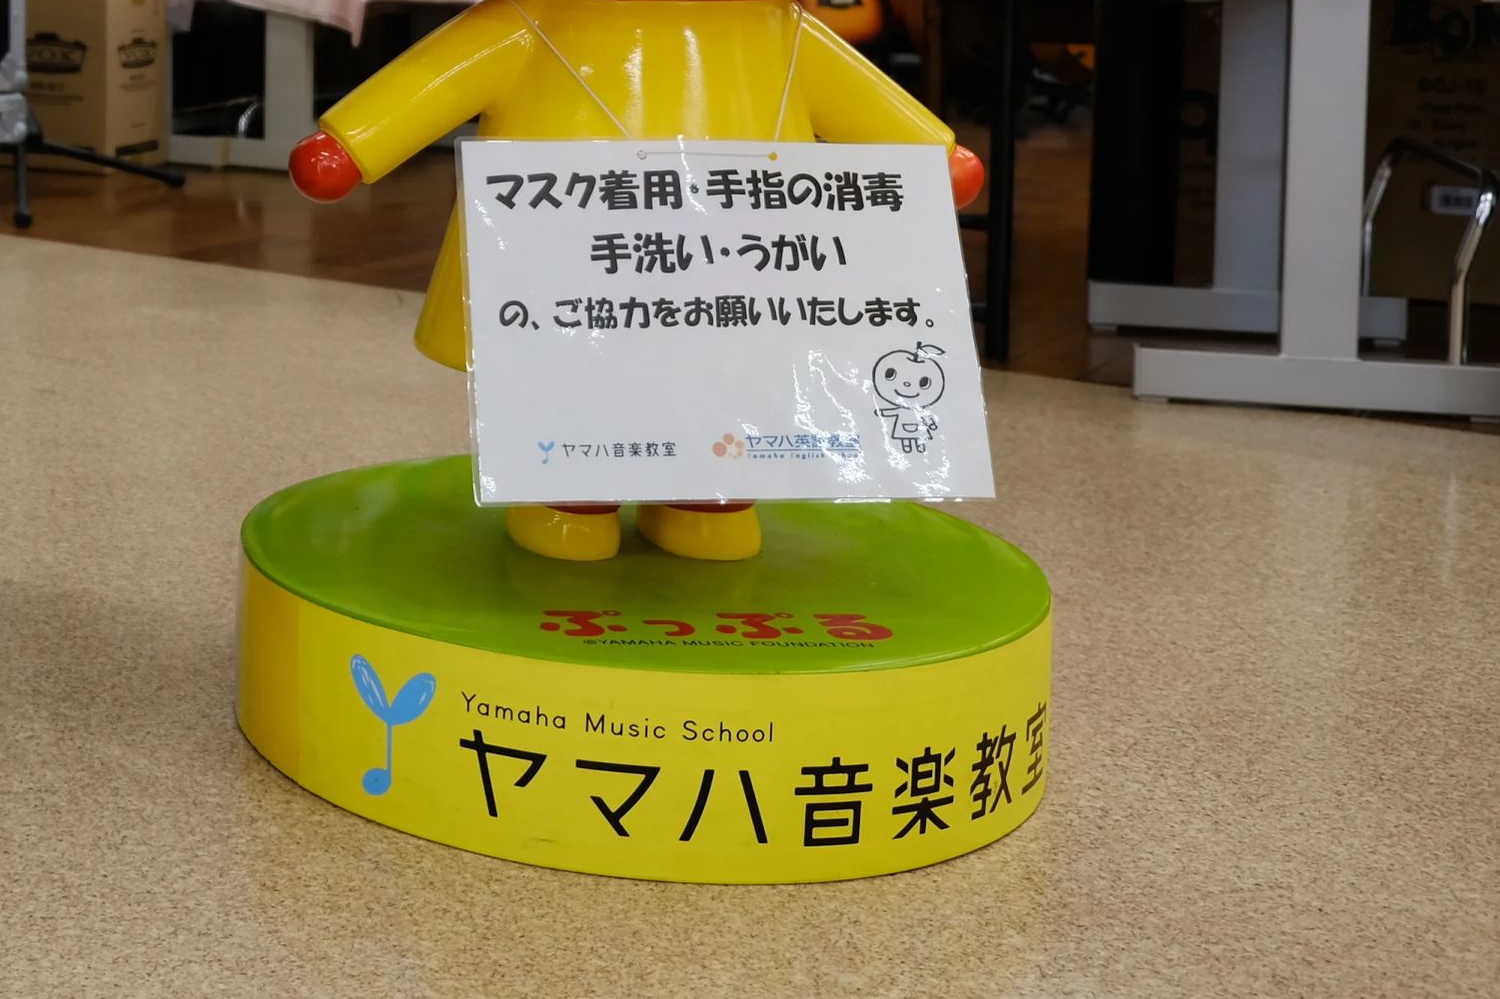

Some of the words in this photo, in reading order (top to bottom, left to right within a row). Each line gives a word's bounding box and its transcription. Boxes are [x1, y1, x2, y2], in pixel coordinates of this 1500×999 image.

[485, 168, 904, 213] マスク着用・手指の消毒
[590, 231, 847, 274] 手洗い・うがい
[499, 294, 935, 330] の、ご協力をお願いいたします。
[561, 441, 677, 458] ヤマハ音楽教室
[539, 609, 894, 641] ぷっぷる
[682, 640, 744, 648] MUSIC
[749, 640, 875, 649] FOUNDATION
[460, 690, 567, 730] Yamaha
[585, 712, 667, 740] Music
[681, 719, 774, 743] School
[458, 701, 1047, 848] ヤマハ音楽教室
